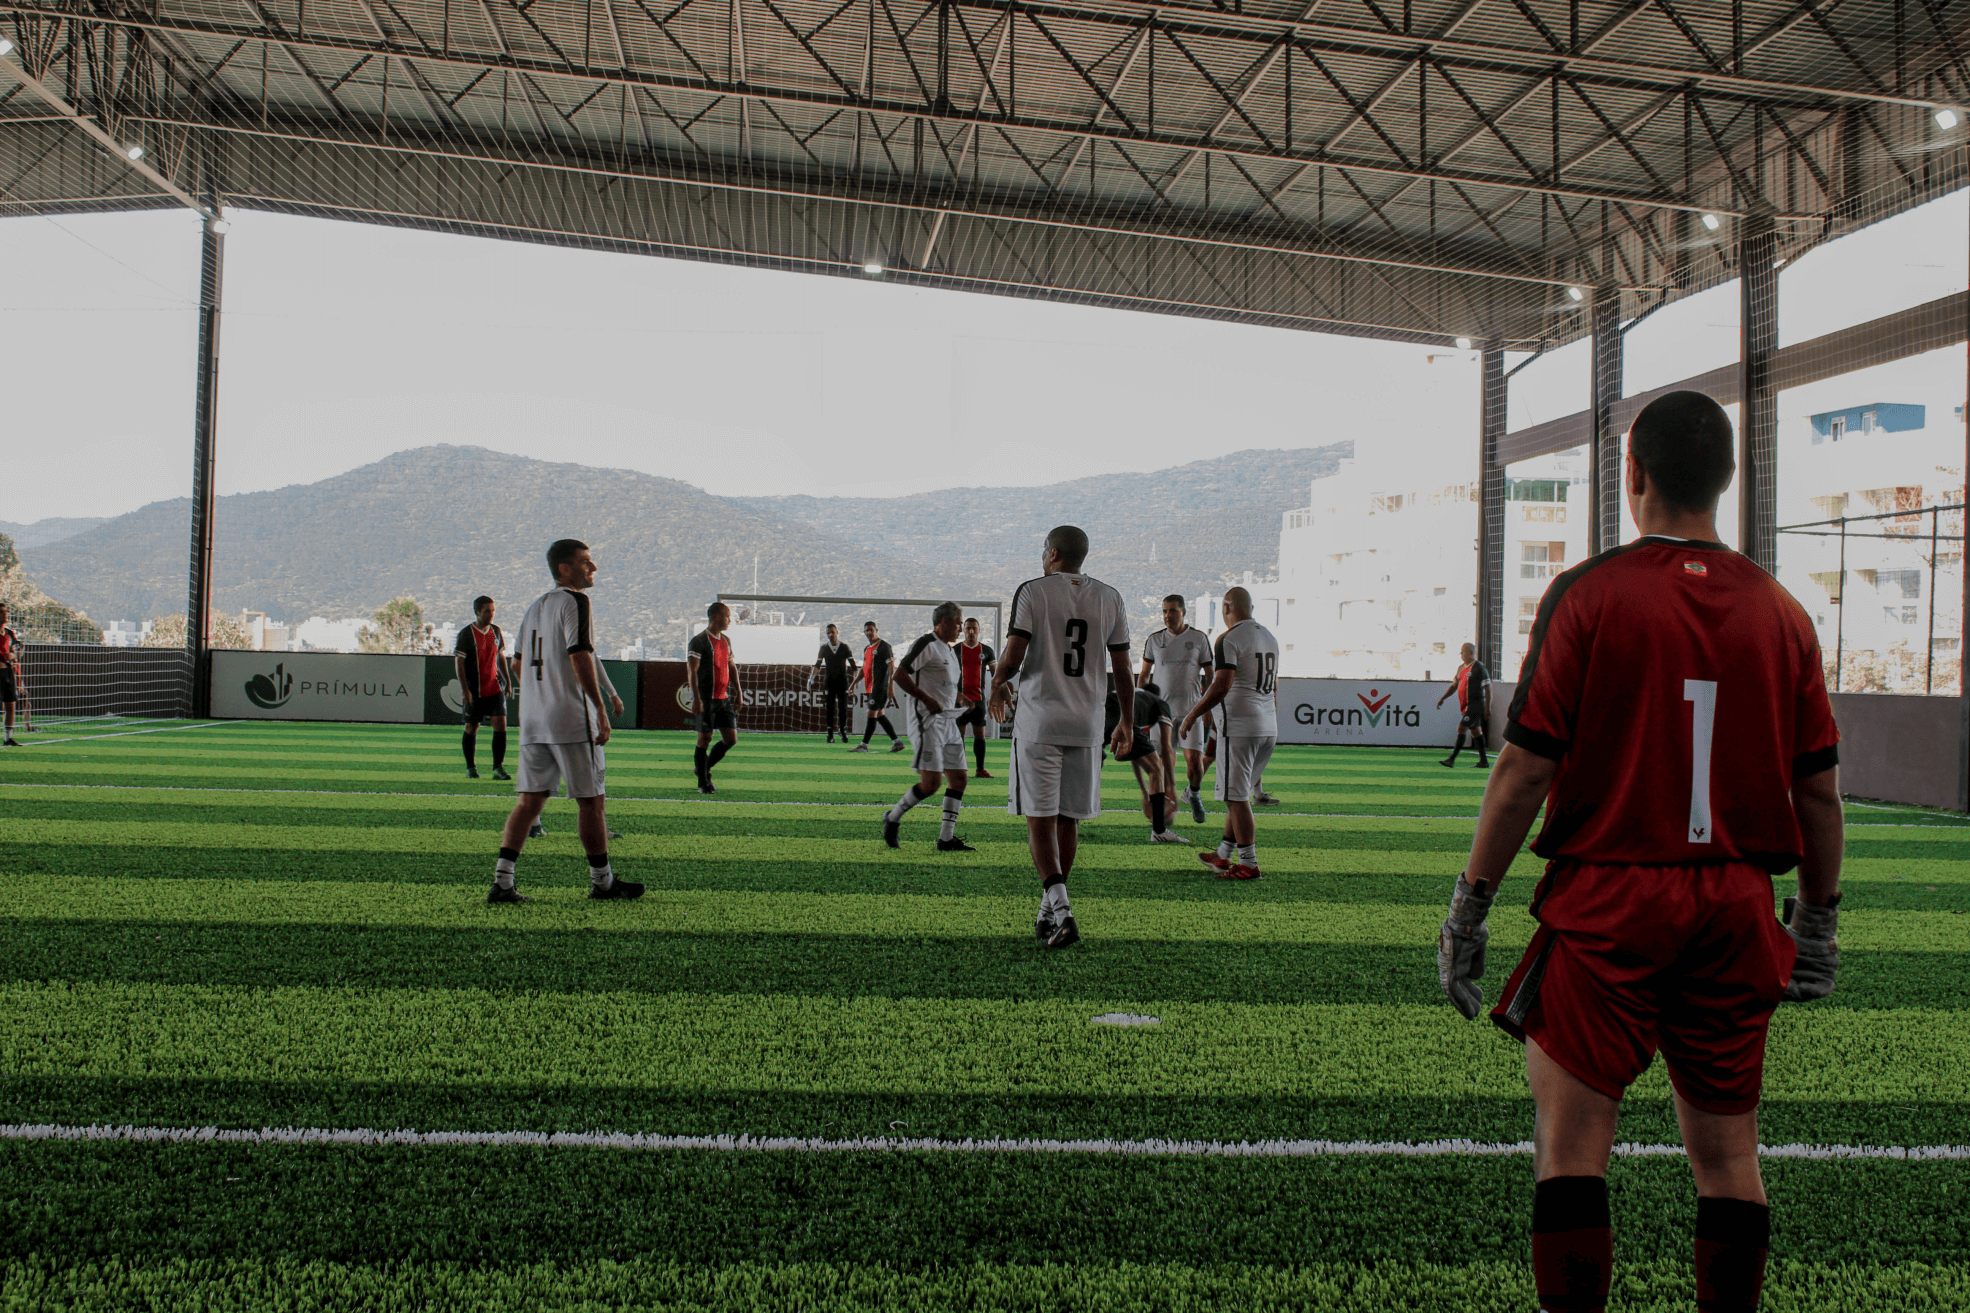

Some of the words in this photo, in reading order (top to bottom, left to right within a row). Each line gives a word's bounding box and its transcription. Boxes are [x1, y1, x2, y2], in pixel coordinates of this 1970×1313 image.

[530, 629, 544, 681] 4
[1063, 618, 1088, 677] 3
[300, 679, 409, 698] PRÍMULA
[1255, 652, 1276, 695] 18
[1313, 728, 1364, 736] ARENA
[1683, 679, 1718, 844] 1
